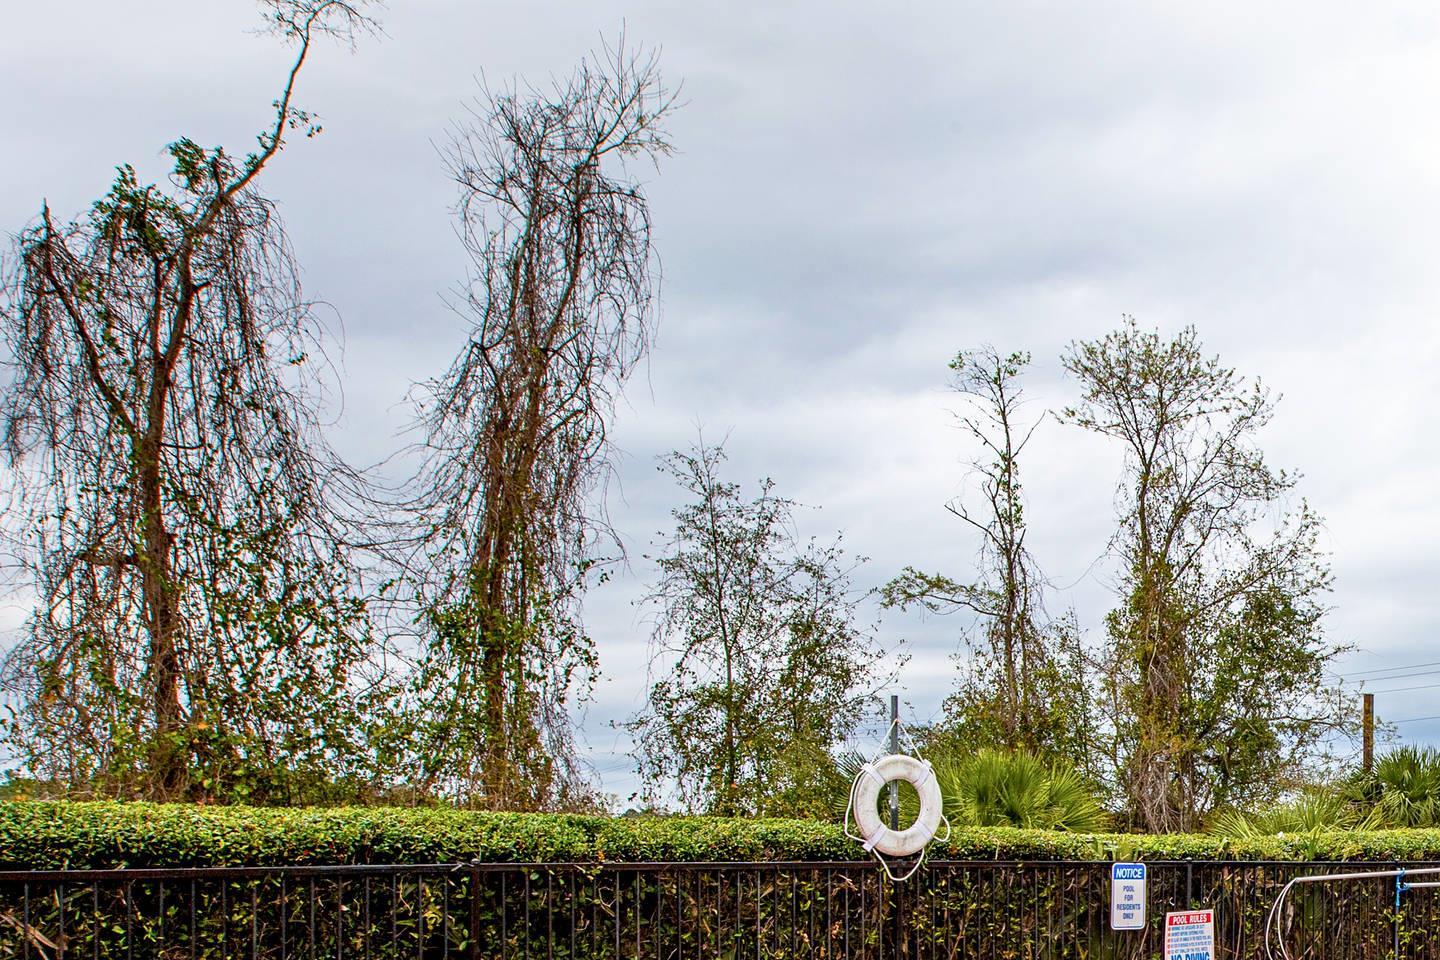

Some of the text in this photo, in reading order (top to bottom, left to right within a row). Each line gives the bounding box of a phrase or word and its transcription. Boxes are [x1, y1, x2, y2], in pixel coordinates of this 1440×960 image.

[1116, 868, 1142, 878] NOTICE
[1116, 903, 1141, 911] RESIDENTS
[1122, 912, 1134, 920] ONLY
[1173, 914, 1207, 924] POOL RULES
